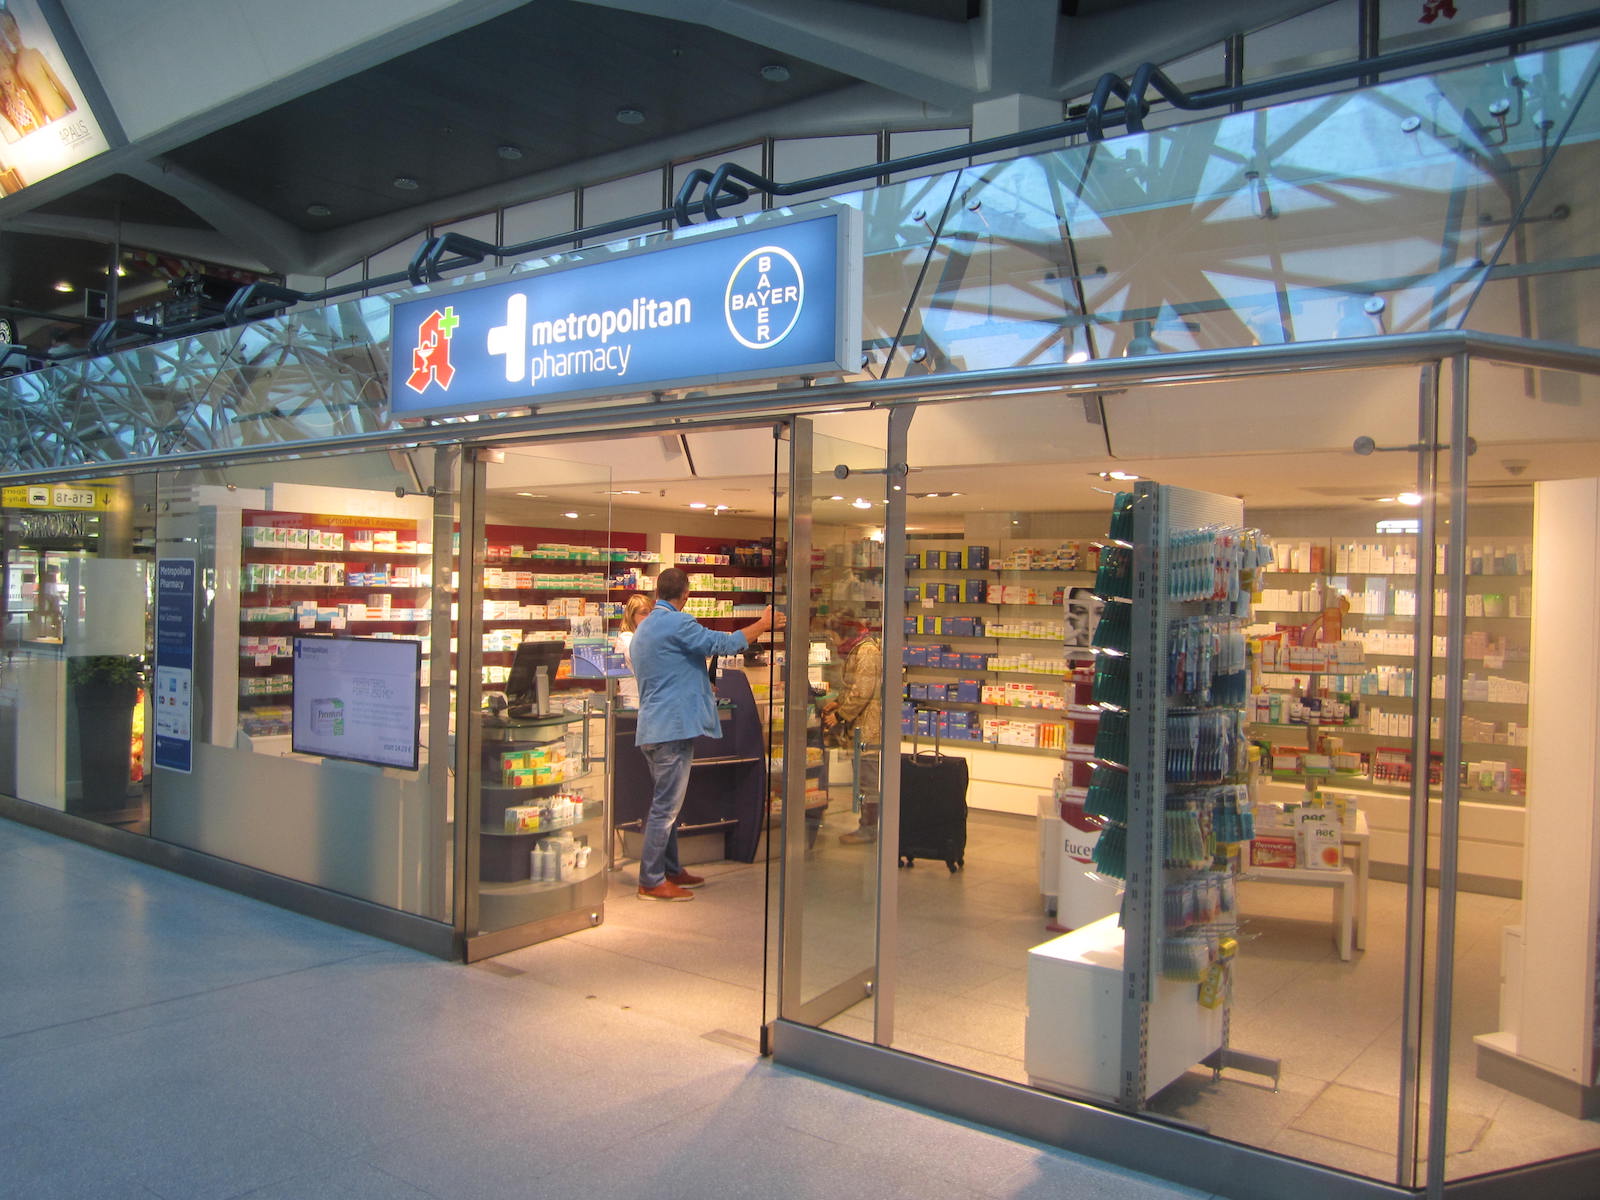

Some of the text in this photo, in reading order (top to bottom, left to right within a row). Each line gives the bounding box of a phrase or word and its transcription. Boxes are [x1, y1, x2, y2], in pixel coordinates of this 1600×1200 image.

[731, 286, 798, 310] BAYER
[532, 297, 691, 343] metropolitan
[531, 344, 631, 387] pharmacy
[160, 566, 192, 577] Metropolitan
[160, 578, 185, 591] Pharmacy
[1064, 839, 1095, 857] Euce
